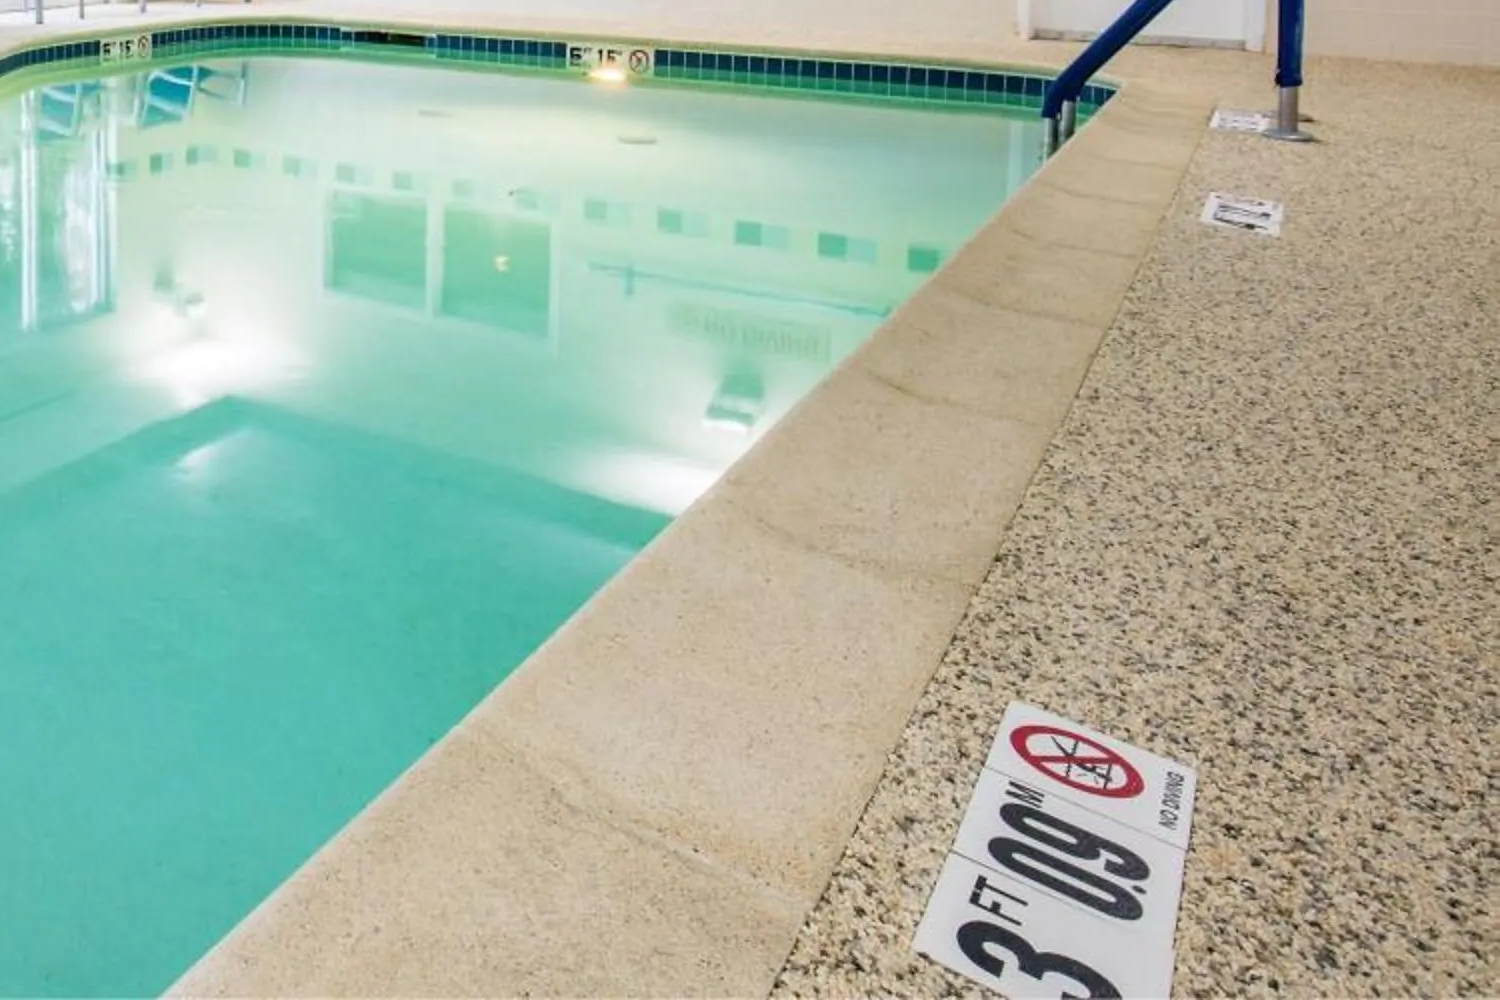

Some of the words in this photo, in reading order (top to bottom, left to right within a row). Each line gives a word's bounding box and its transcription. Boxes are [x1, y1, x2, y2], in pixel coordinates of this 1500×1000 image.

[1160, 771, 1185, 812] DIVING
[1158, 808, 1179, 831] NO
[969, 875, 1028, 926] FT
[956, 920, 1123, 1000] 3
